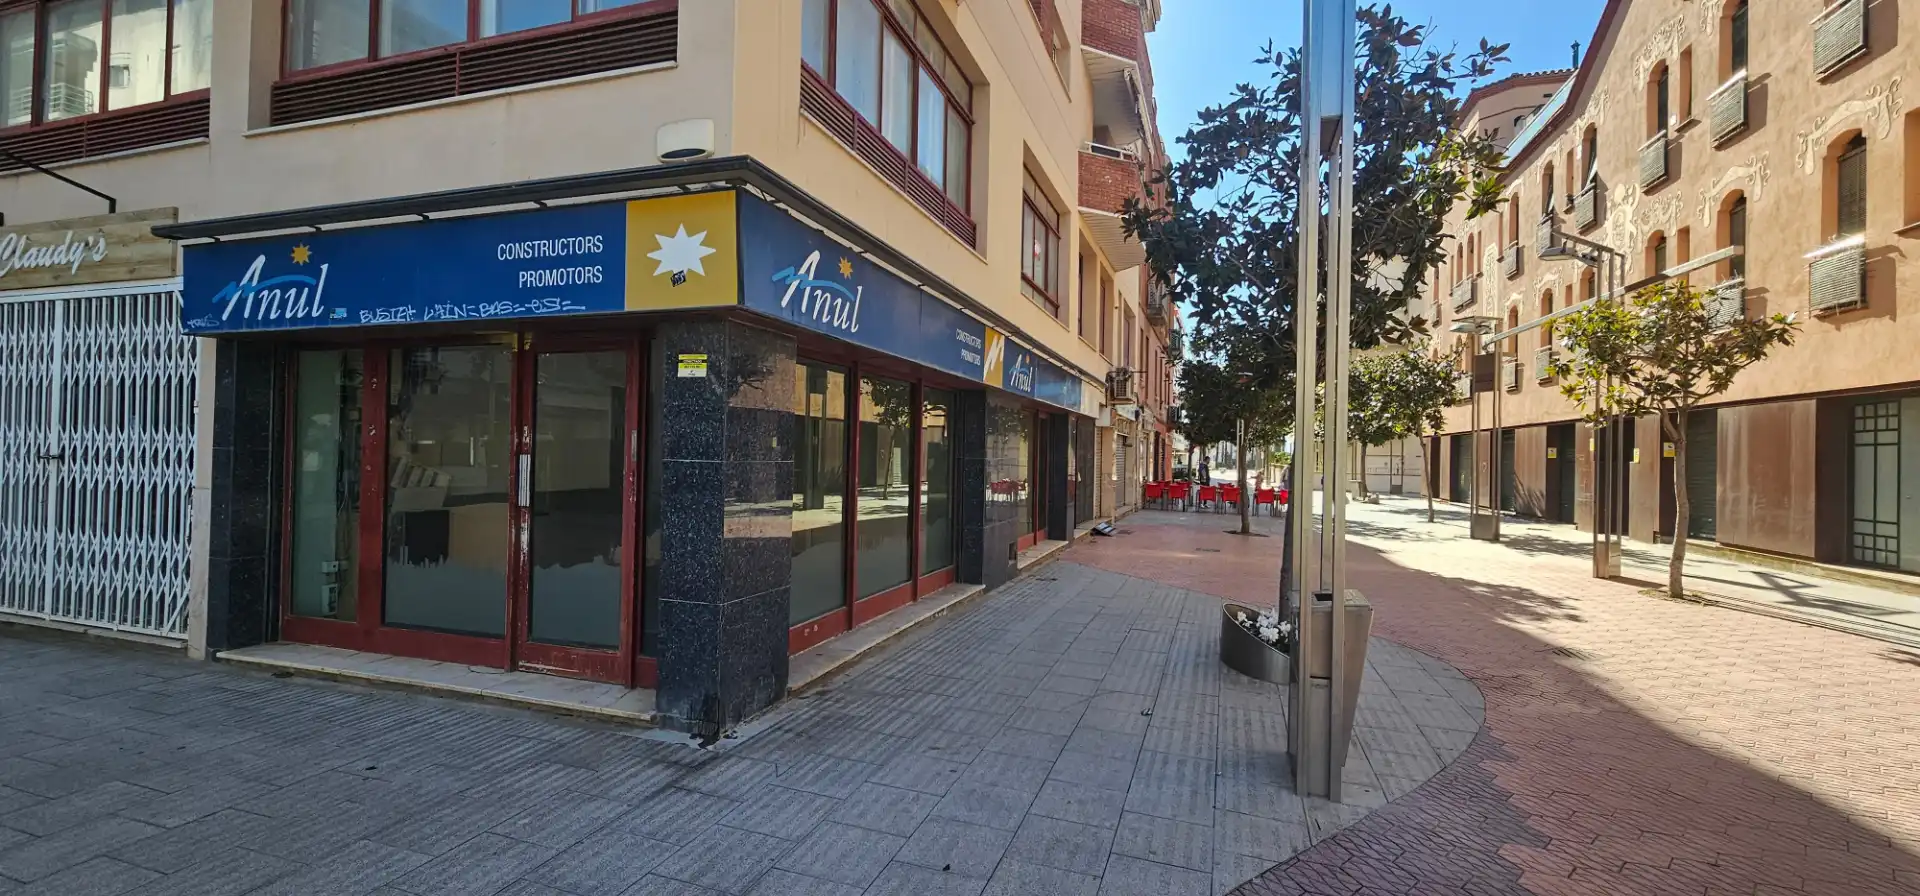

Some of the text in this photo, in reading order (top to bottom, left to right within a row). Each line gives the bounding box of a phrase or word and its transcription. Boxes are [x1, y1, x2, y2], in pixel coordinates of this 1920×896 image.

[0, 231, 108, 276] Claudy's
[497, 235, 603, 261] CONSTRUCTORS
[221, 254, 329, 321] Anul
[518, 265, 603, 288] PROMOTORS
[781, 249, 863, 333] Anul
[955, 328, 982, 350] CONSTRUCTORS
[1010, 353, 1033, 393] Anul
